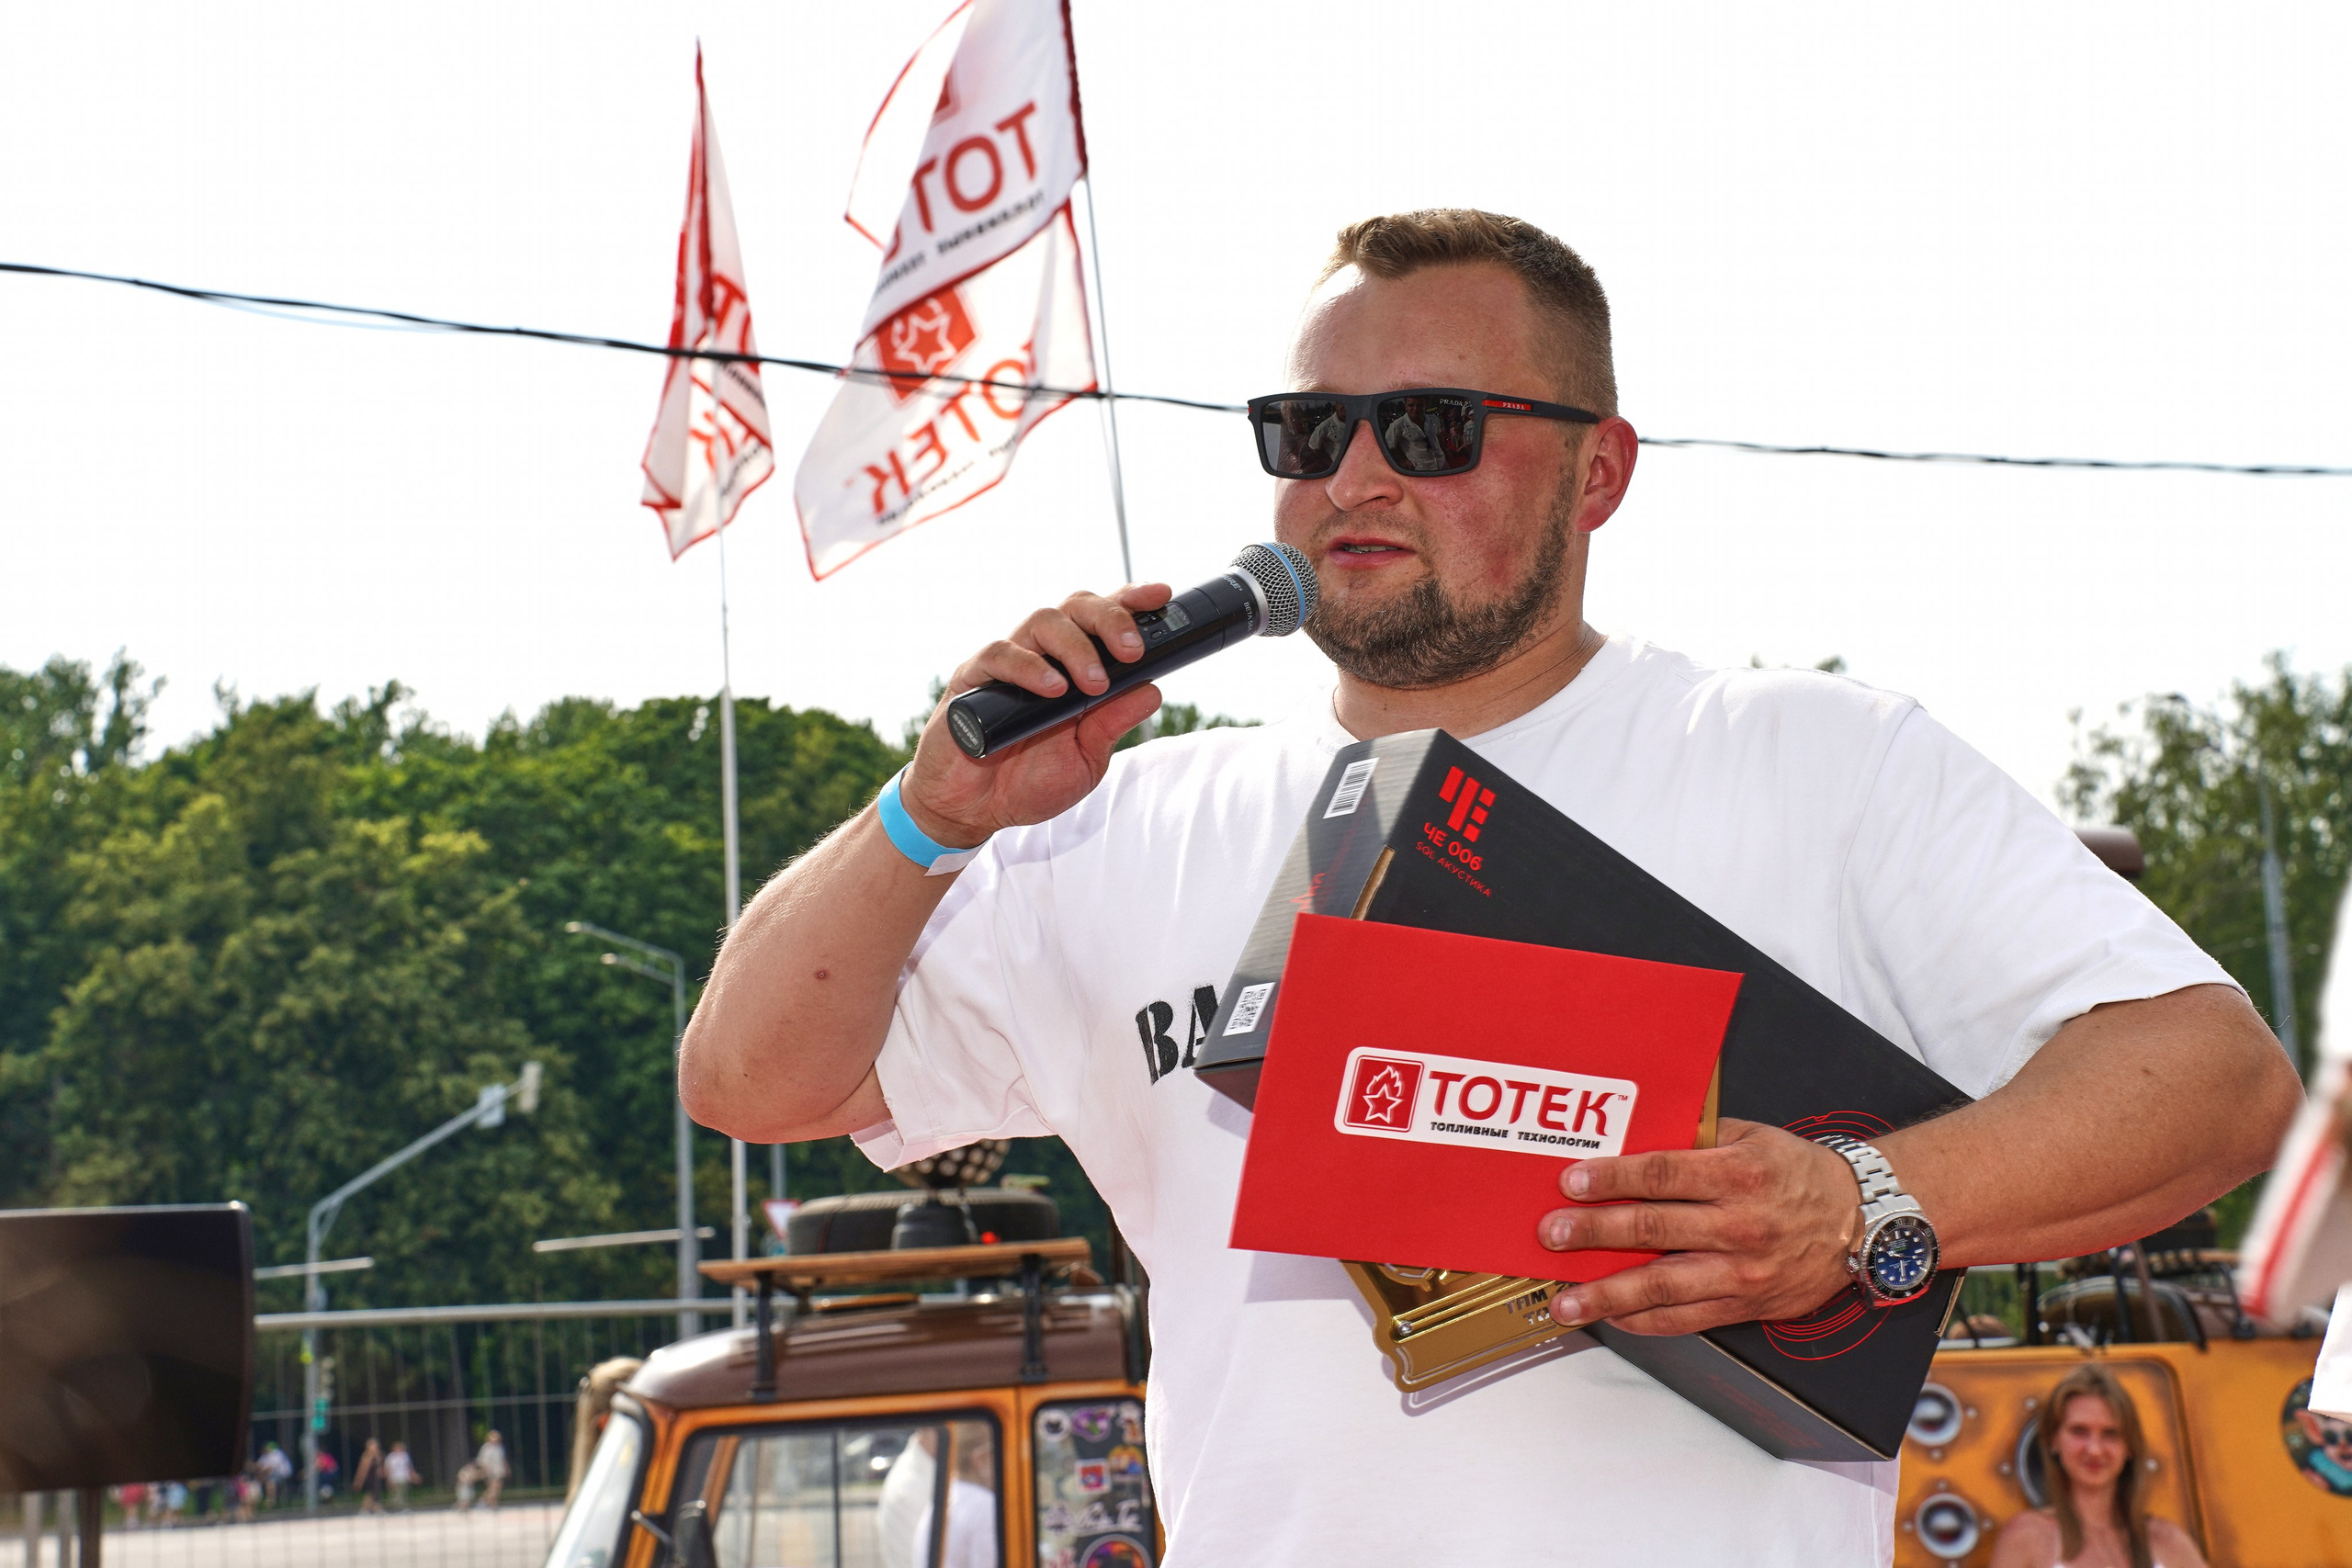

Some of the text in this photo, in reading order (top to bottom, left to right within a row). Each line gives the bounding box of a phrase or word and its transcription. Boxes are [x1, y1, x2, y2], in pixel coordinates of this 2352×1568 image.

[1440, 398, 1464, 407] PRADA
[1503, 401, 1525, 411] PRADA
[1244, 602, 1253, 620] BETA
[953, 714, 978, 745] SHURE
[1423, 822, 1484, 871] ЧЕ 006
[1416, 841, 1492, 897] SQL АКУСТИКА
[1429, 1070, 1617, 1137] ТОТЕК
[1430, 1121, 1600, 1150] ТОПЛИВНЫЕ ТЕХНОЛОГИИ
